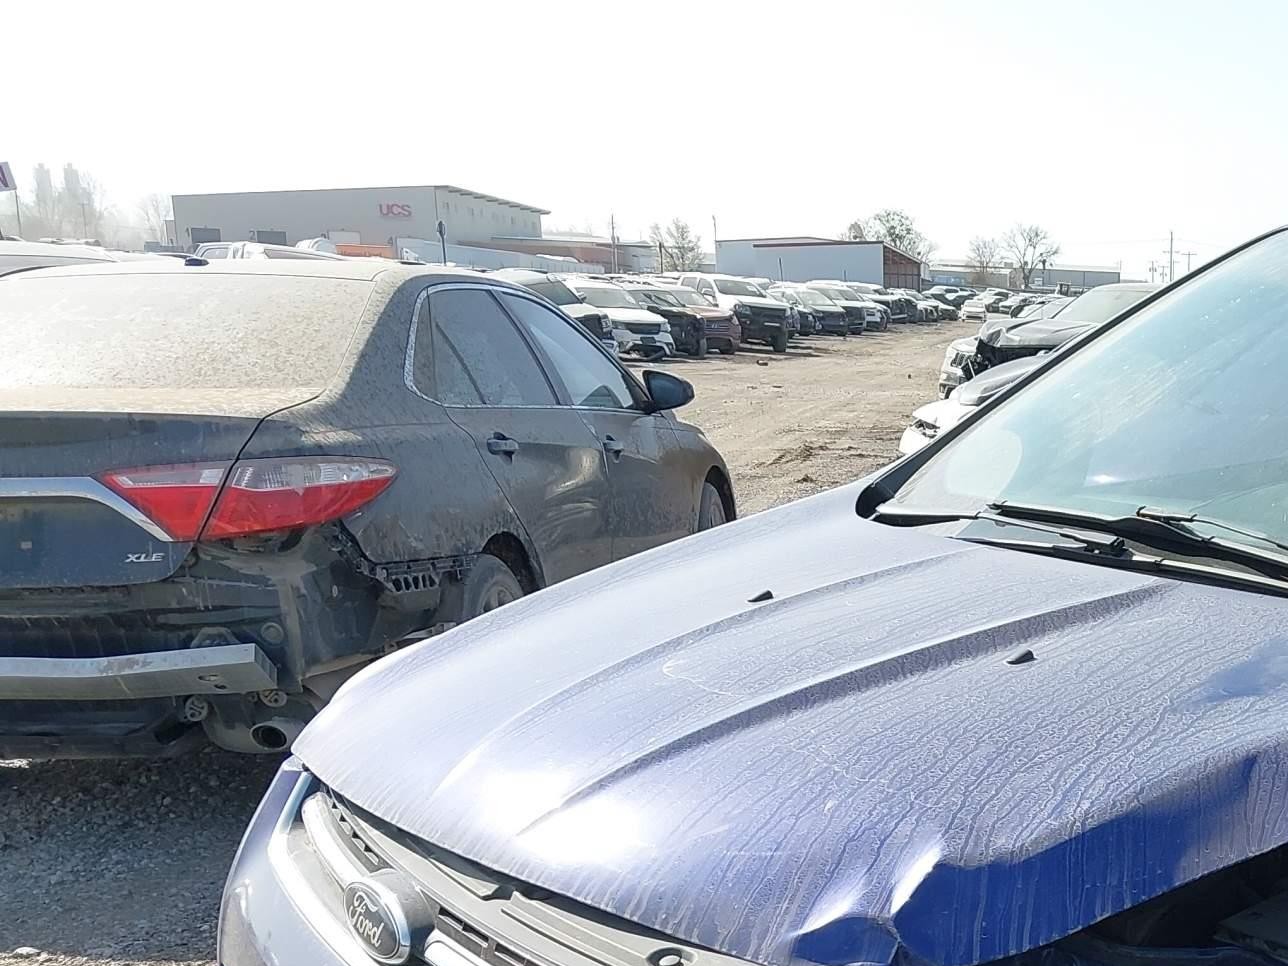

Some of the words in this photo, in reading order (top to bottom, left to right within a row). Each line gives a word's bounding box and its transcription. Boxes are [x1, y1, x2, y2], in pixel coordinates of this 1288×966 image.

[378, 203, 413, 217] UCS
[124, 552, 166, 563] XLE
[348, 891, 386, 948] Ford
